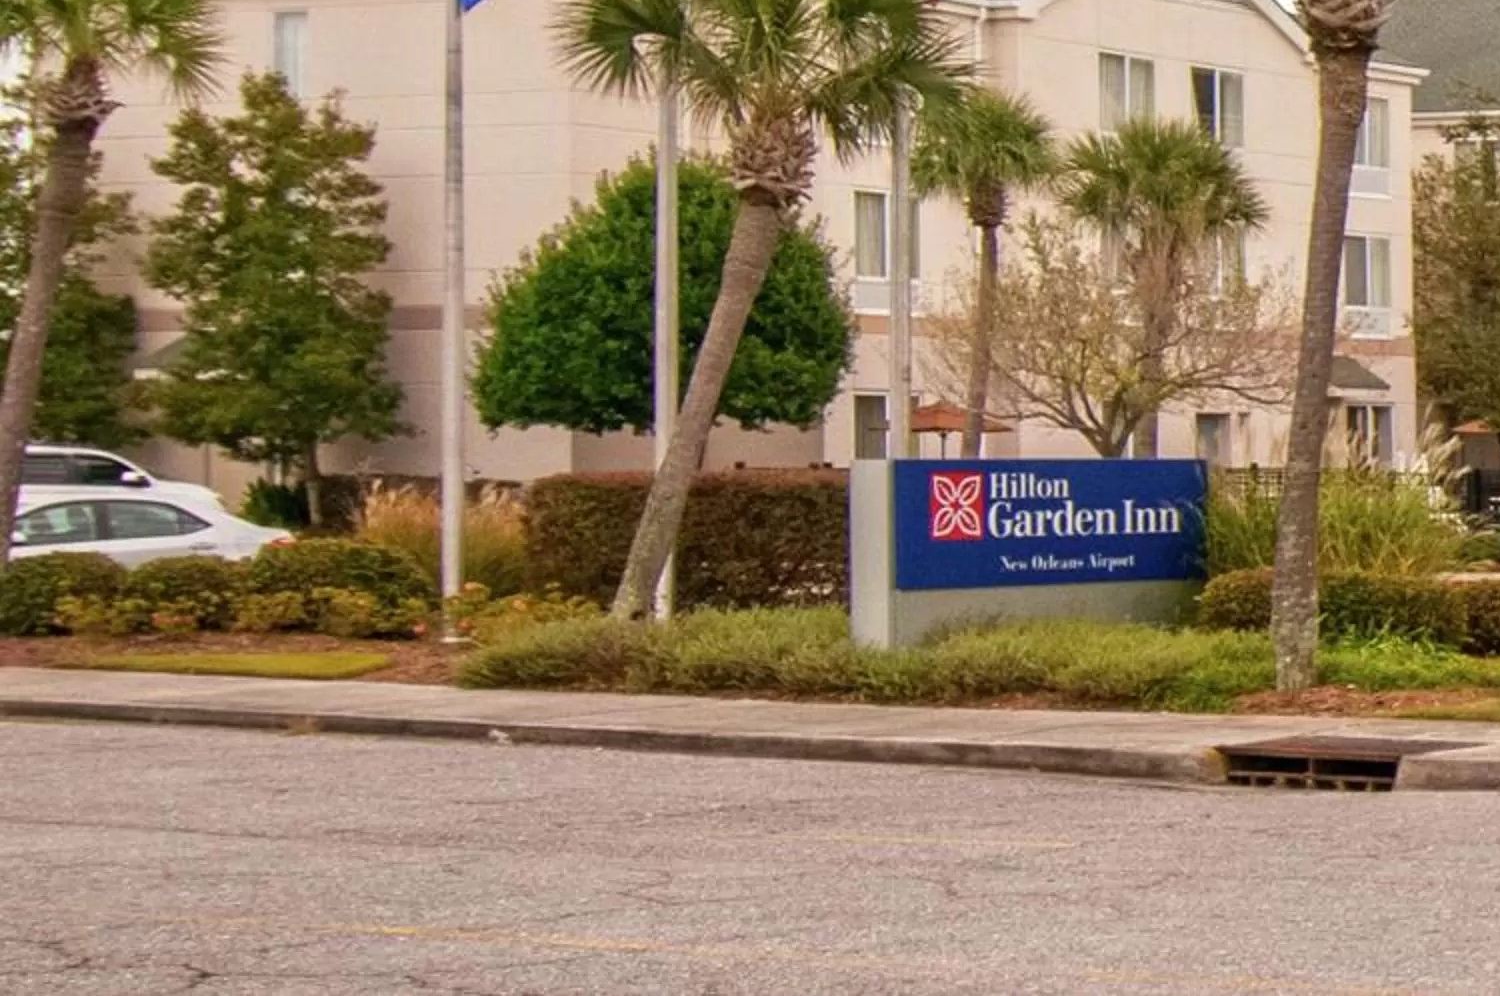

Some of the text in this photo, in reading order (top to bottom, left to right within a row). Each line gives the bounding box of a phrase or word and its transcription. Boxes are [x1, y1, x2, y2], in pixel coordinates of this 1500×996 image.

[989, 472, 1069, 499] Hilton
[988, 499, 1181, 538] Garden Inn
[1000, 553, 1135, 572] New Orleans Airport
